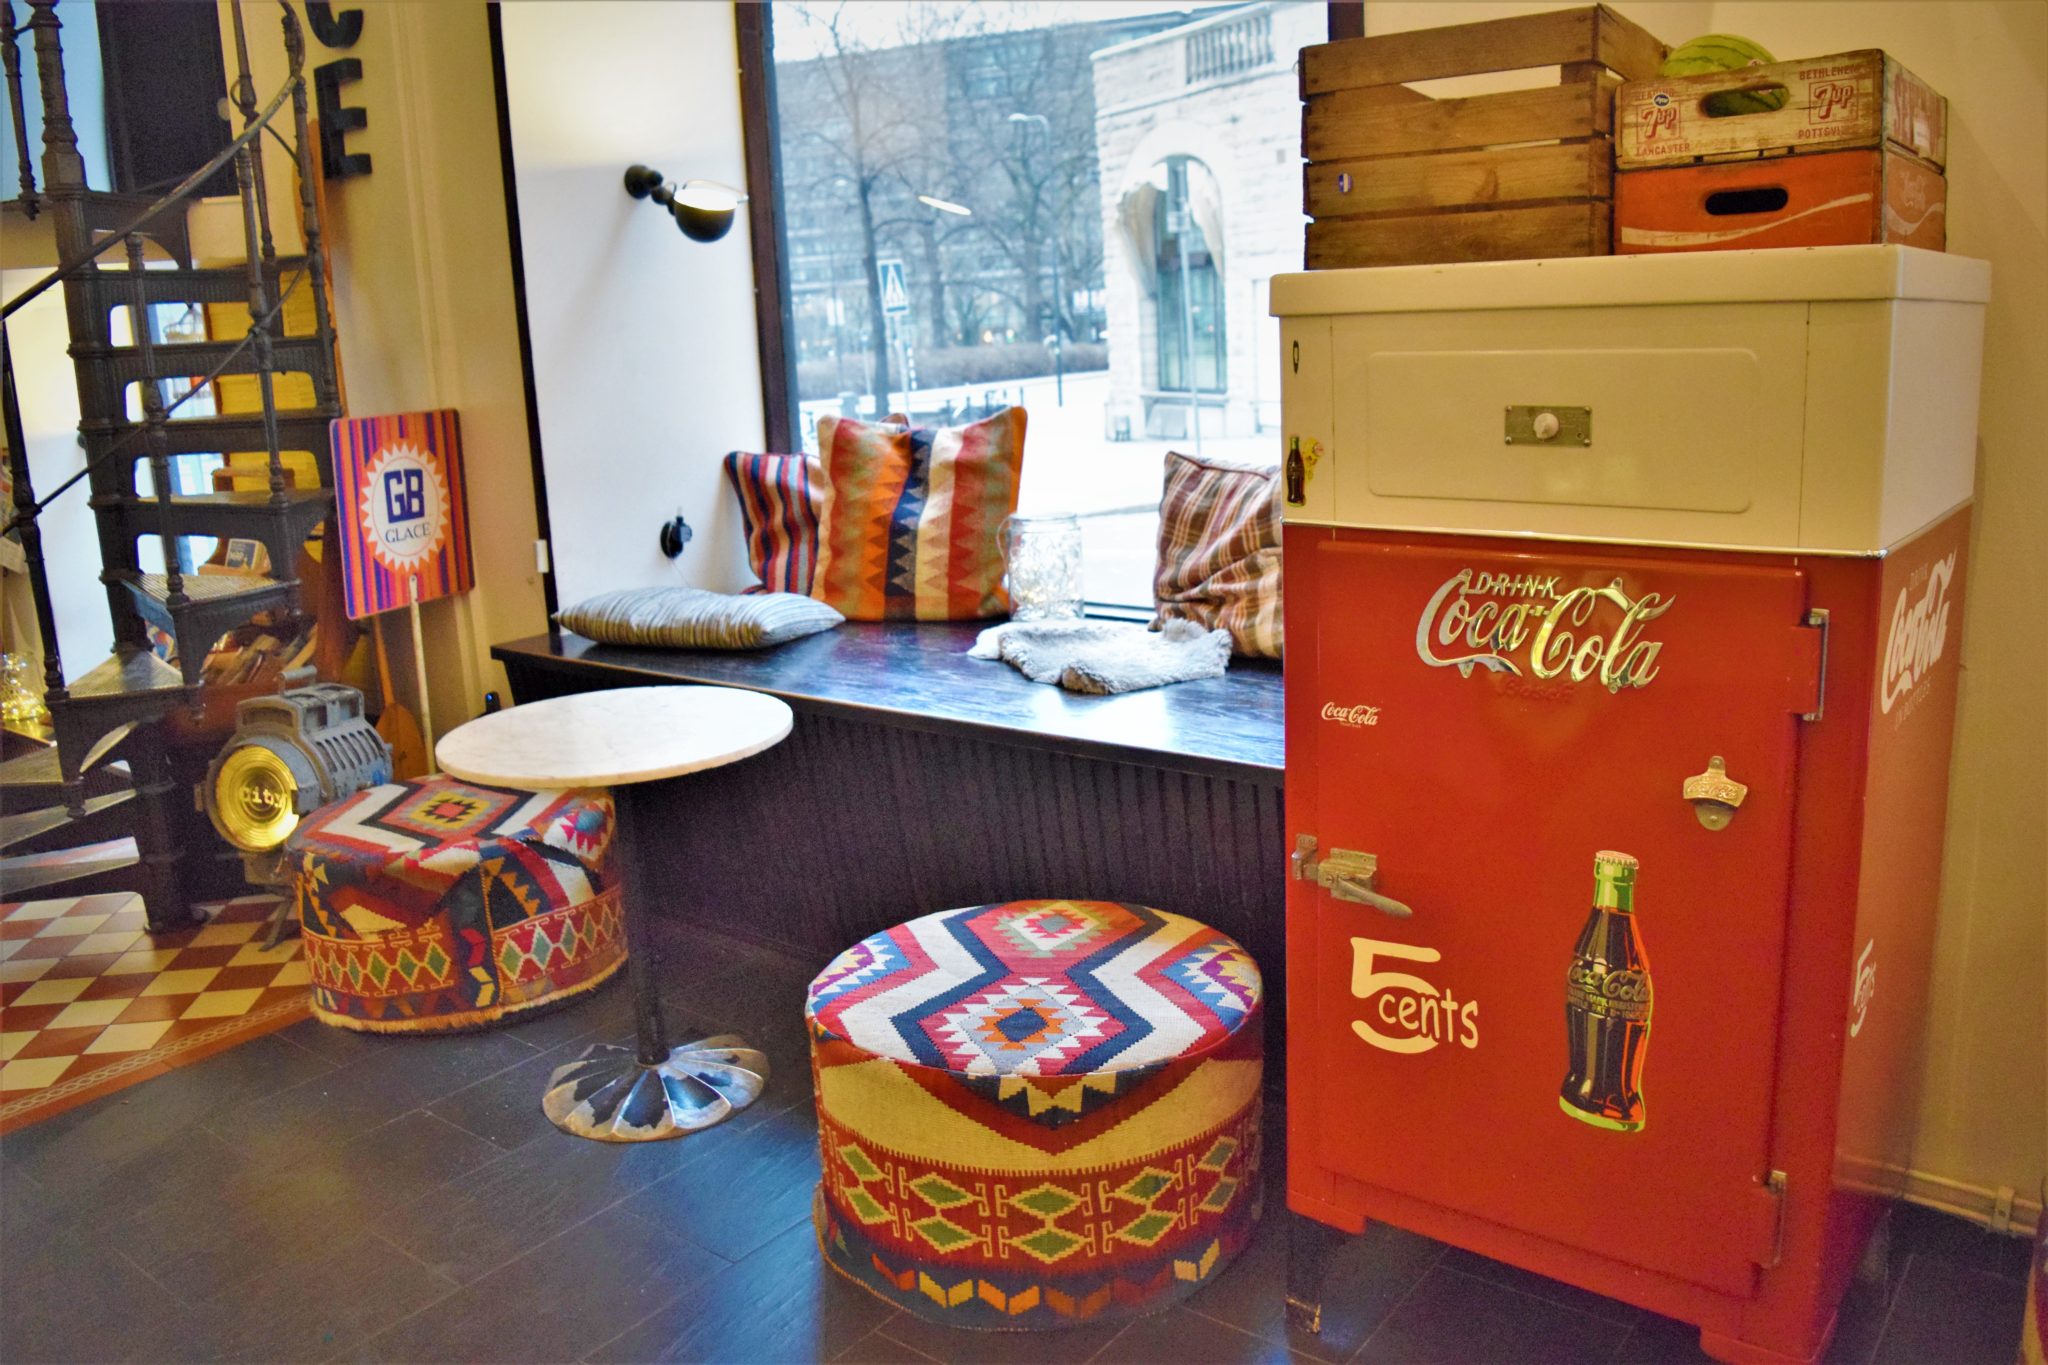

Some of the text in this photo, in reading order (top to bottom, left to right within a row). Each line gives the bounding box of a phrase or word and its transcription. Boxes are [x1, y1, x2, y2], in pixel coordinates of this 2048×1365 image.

[1636, 143, 1690, 156] LANCASTER
[383, 468, 425, 524] GB
[385, 522, 431, 543] GLACE
[1474, 573, 1562, 599] DRINK
[1350, 936, 1479, 1054] 5 cents
